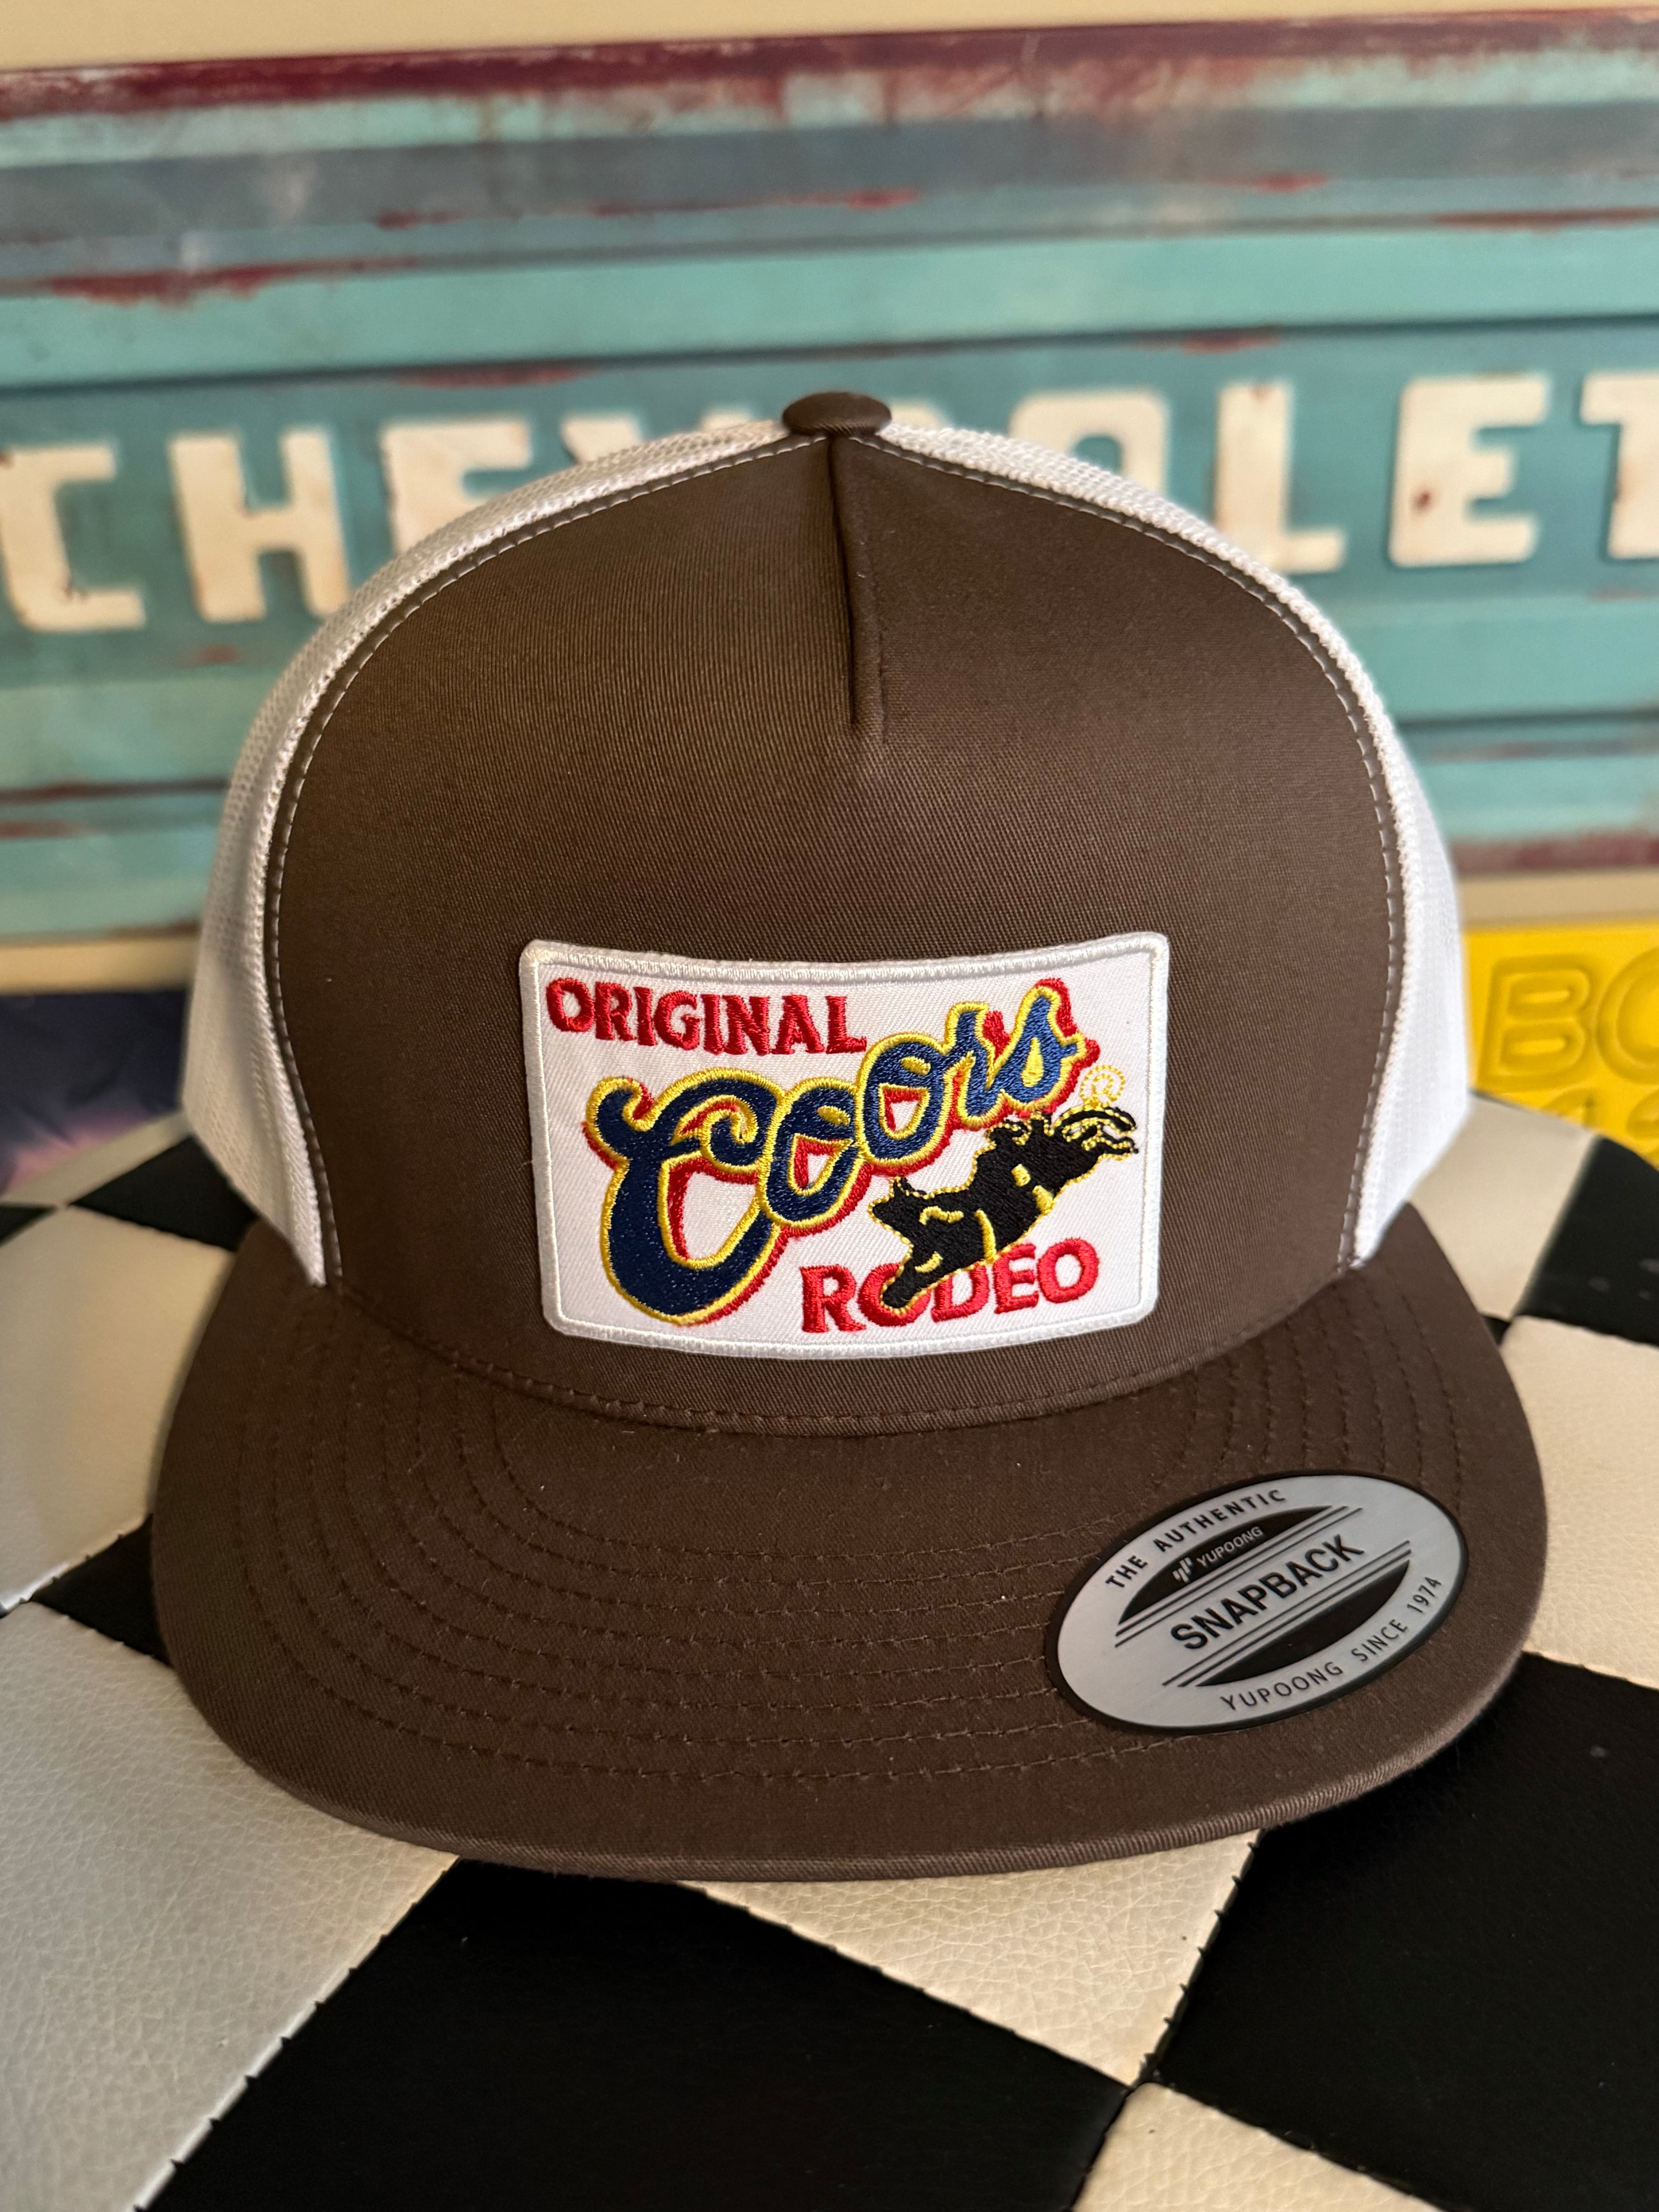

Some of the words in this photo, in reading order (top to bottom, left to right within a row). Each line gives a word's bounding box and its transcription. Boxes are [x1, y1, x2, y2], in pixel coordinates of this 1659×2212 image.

[1, 372, 1659, 630] CHEOLET
[546, 977, 868, 1055] ORIGINAL
[581, 978, 1100, 1326] Coors
[800, 1237, 1100, 1334] RODEO
[1105, 1554, 1148, 1590] THE
[1152, 1489, 1287, 1553] AUTHENTIC
[1170, 1534, 1365, 1650] SNAPBACK
[1196, 1526, 1264, 1567] YUPOONG
[1220, 1662, 1344, 1712] YUPOONG
[1351, 1618, 1408, 1663] SINCE
[1407, 1576, 1443, 1615] 1974
